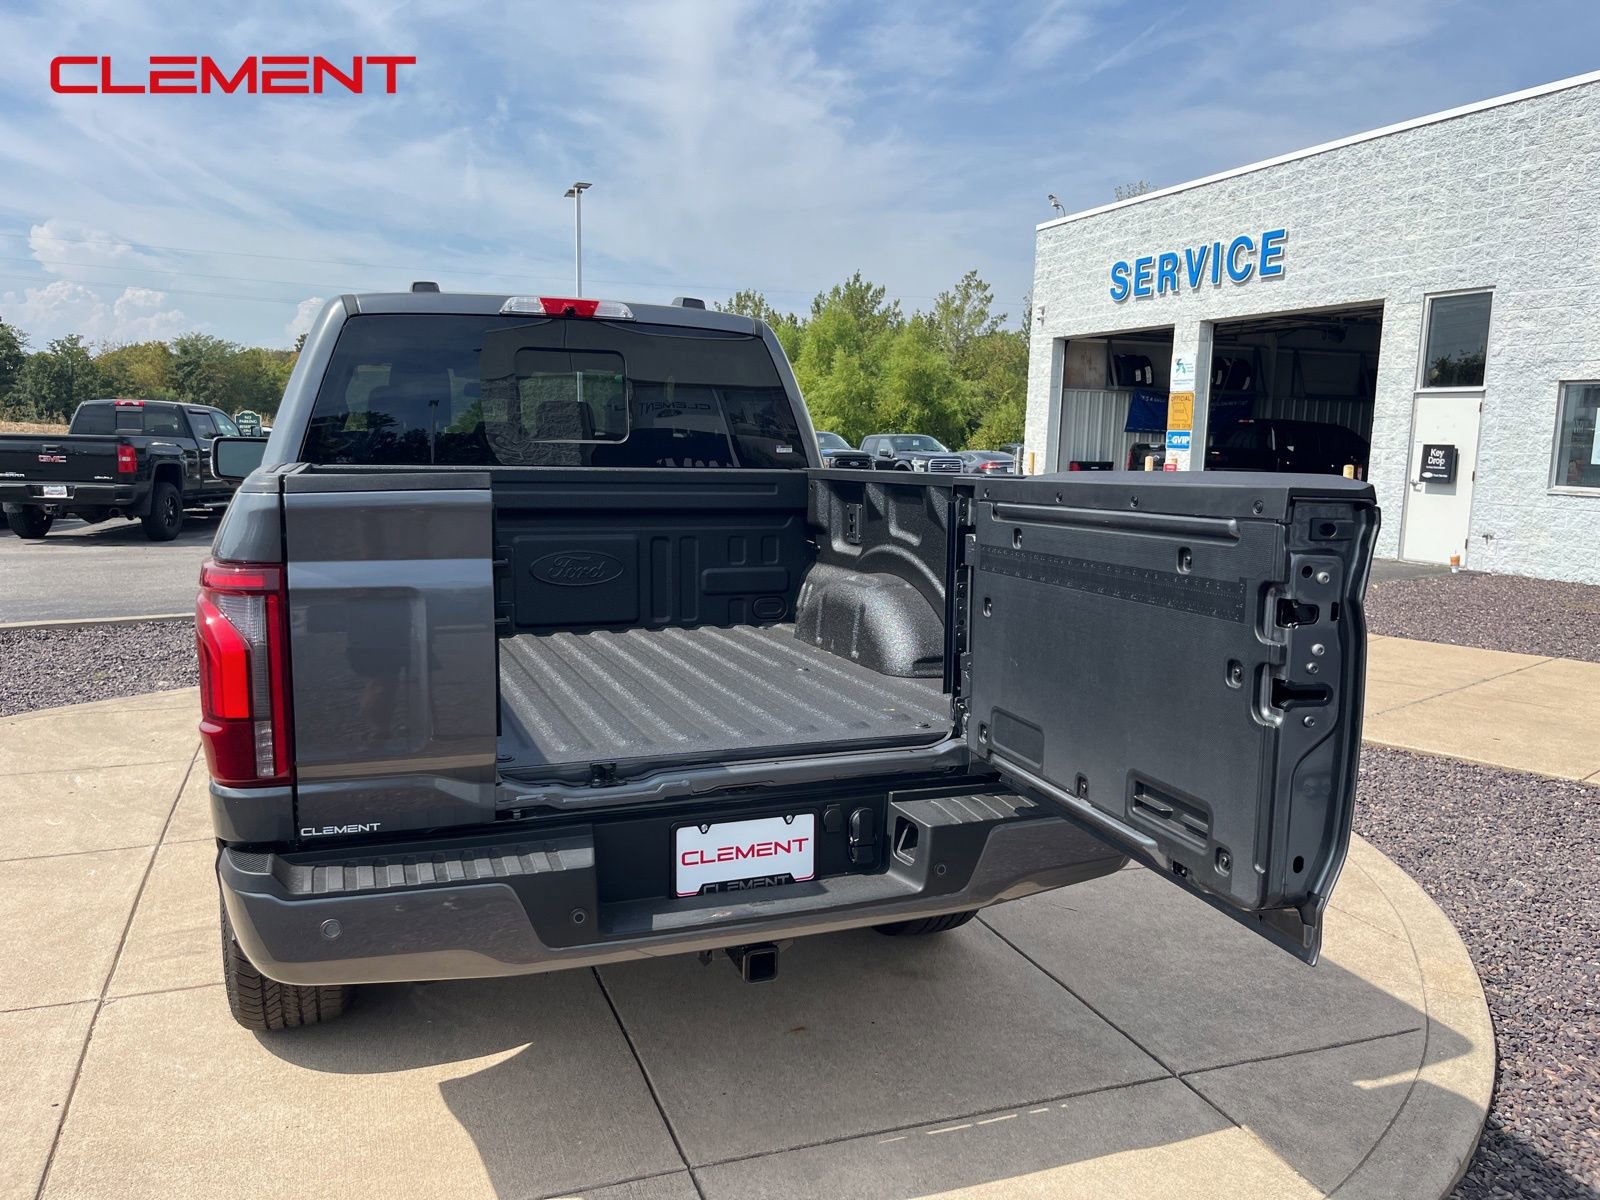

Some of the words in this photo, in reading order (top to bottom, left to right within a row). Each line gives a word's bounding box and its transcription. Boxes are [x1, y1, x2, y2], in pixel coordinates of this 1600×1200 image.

[1110, 228, 1286, 302] SERVICE
[38, 454, 67, 463] GMC
[1430, 448, 1445, 459] Key
[1428, 456, 1446, 467] Drop
[547, 555, 606, 578] Ford
[301, 822, 381, 836] CLEMENT
[681, 838, 809, 866] CLEMENT
